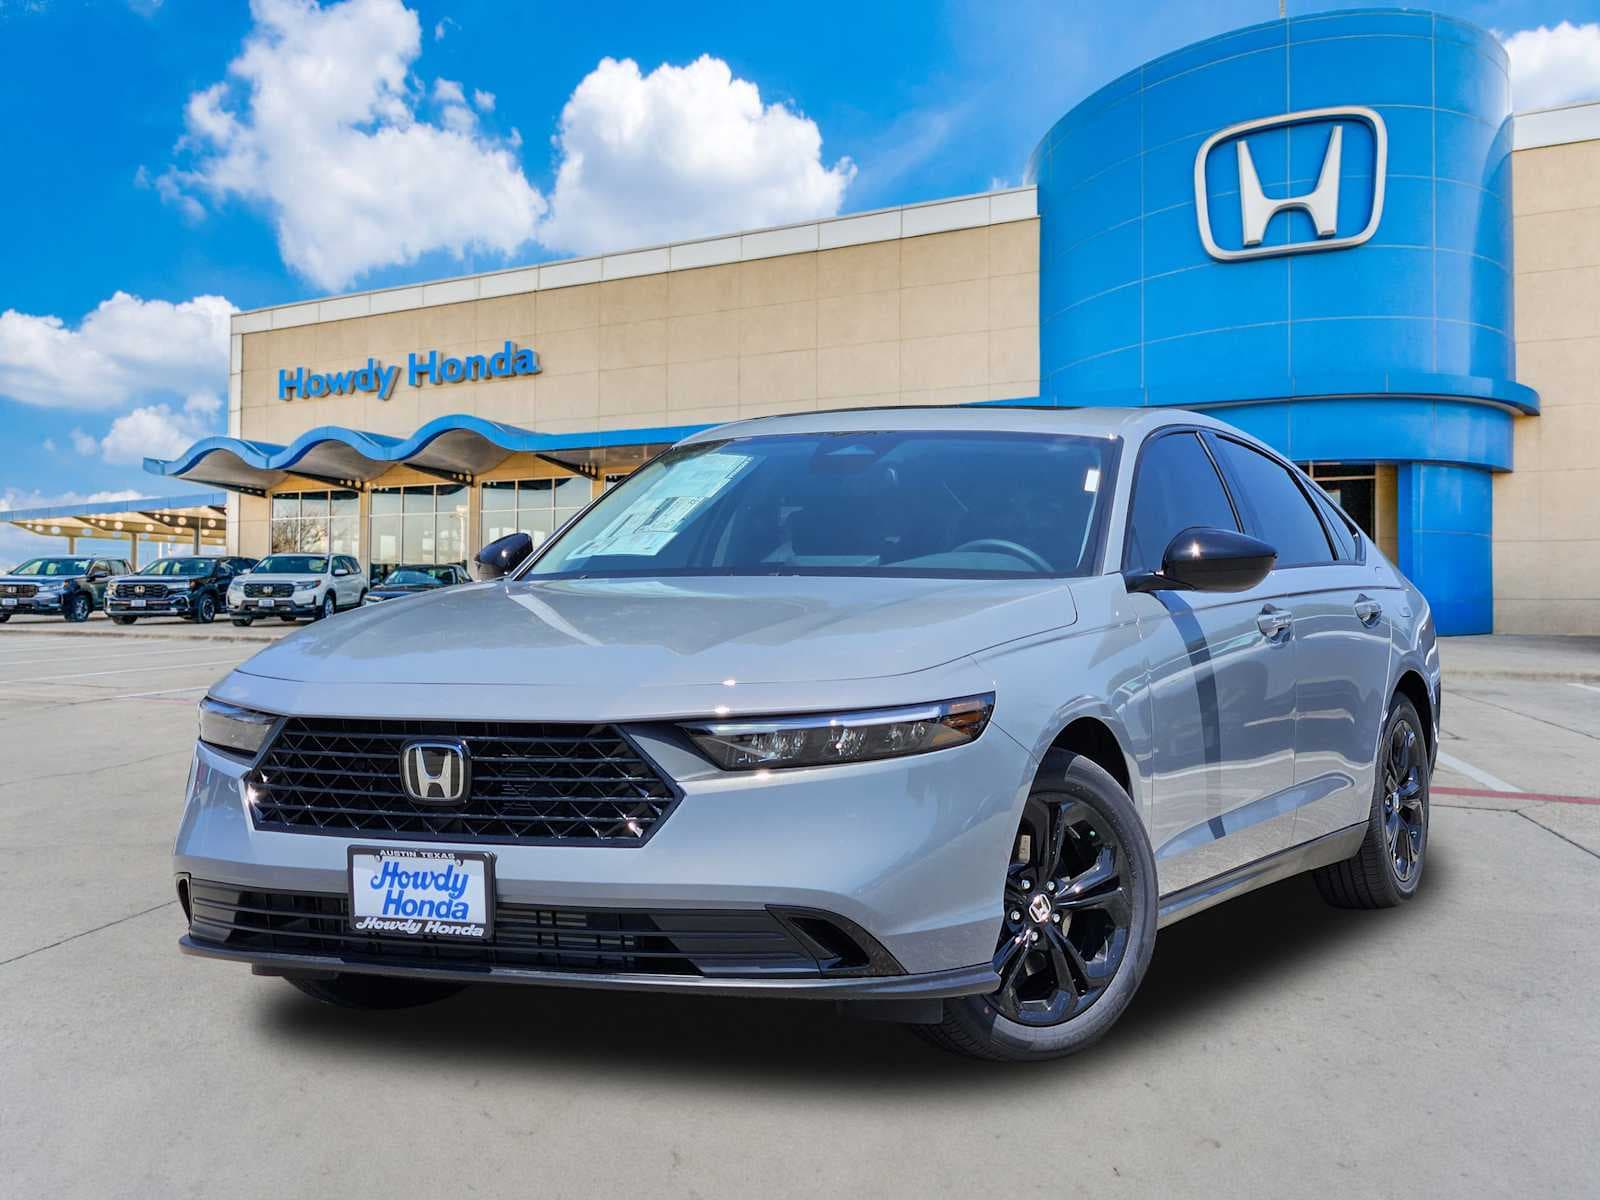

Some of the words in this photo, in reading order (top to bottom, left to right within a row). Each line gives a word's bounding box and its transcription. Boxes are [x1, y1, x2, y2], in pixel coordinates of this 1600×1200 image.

[278, 357, 400, 401] Howdy
[408, 340, 540, 387] Honda
[380, 849, 416, 858] AUSTIN
[420, 851, 455, 859] TEXAS
[370, 861, 469, 899] Howdy
[382, 889, 469, 920] Honda
[356, 917, 422, 934] Howdy
[424, 921, 484, 936] Honda
